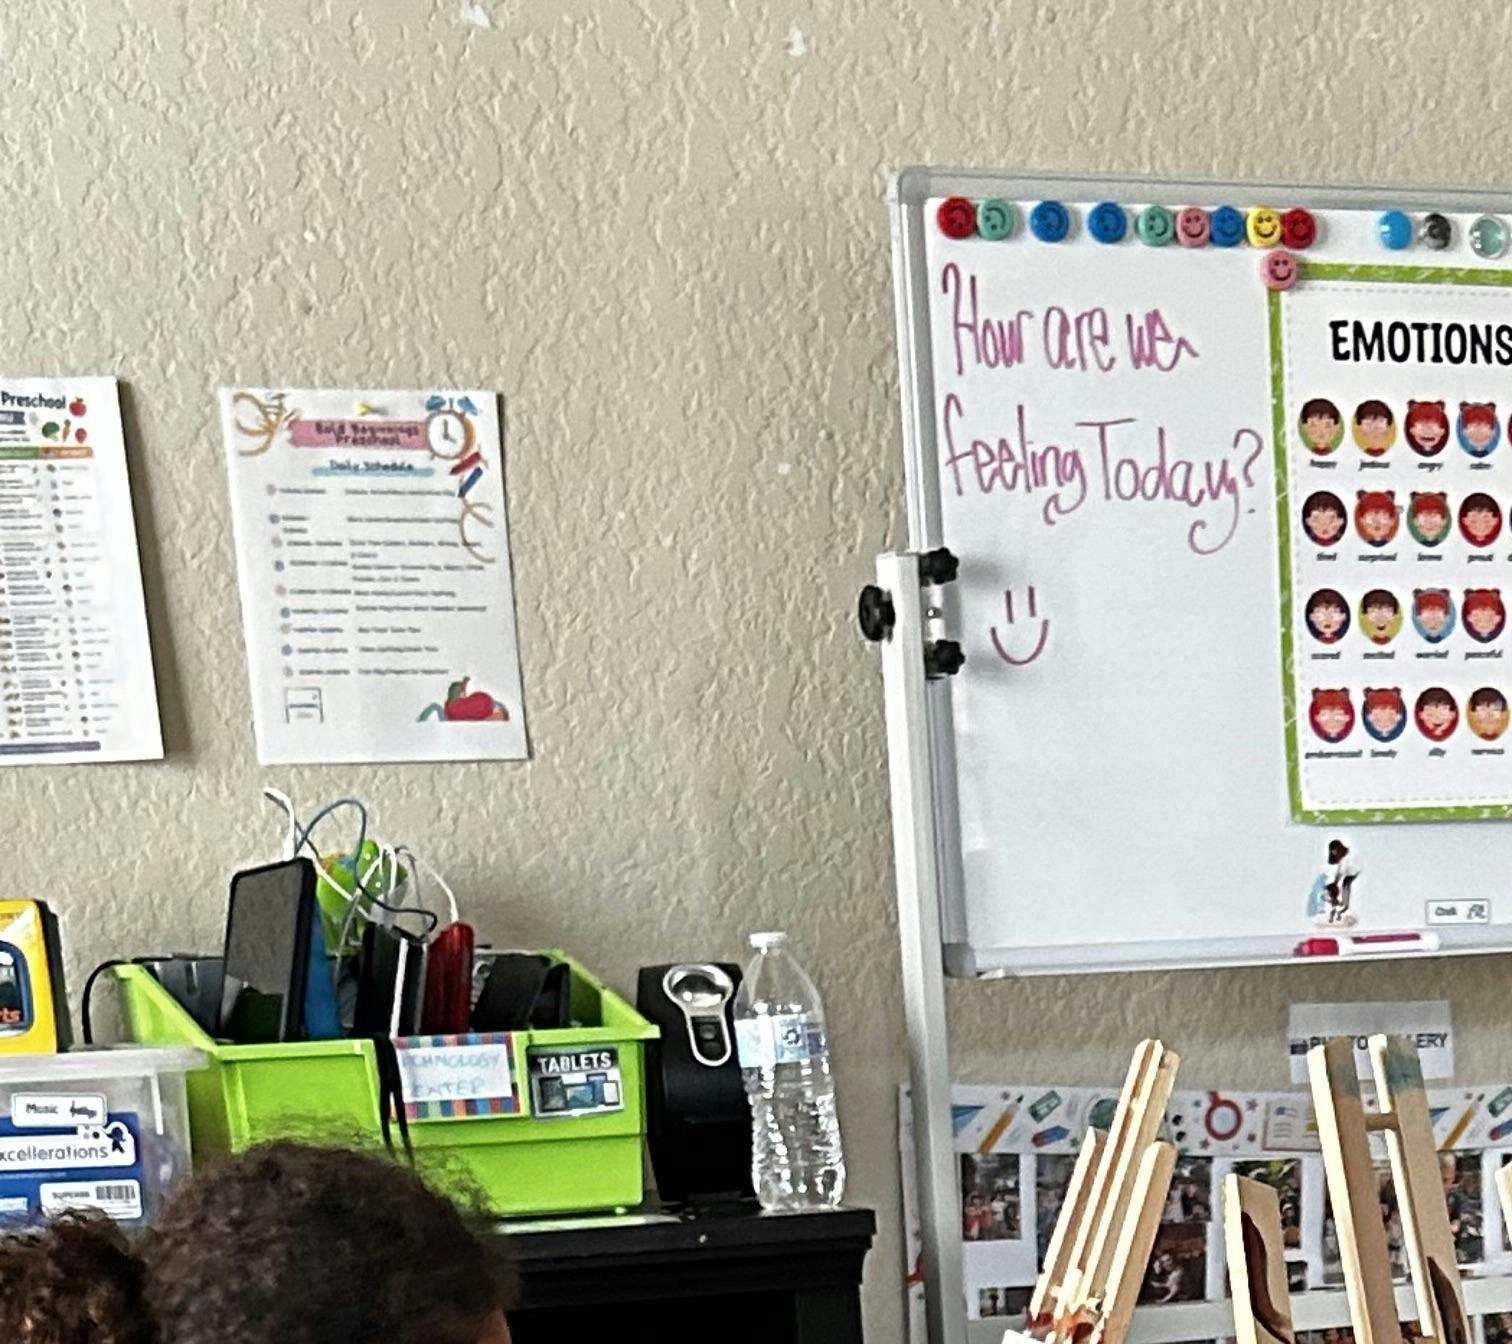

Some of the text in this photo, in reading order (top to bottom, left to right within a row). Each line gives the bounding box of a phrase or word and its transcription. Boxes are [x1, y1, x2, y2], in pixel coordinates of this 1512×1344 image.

[942, 261, 1032, 375] How
[1043, 306, 1115, 372] are
[1, 390, 66, 410] Preschool
[363, 460, 414, 472] Schedule
[944, 393, 1264, 555] feeling Today?
[538, 1051, 612, 1075] TABLETS
[25, 1102, 60, 1115] Music
